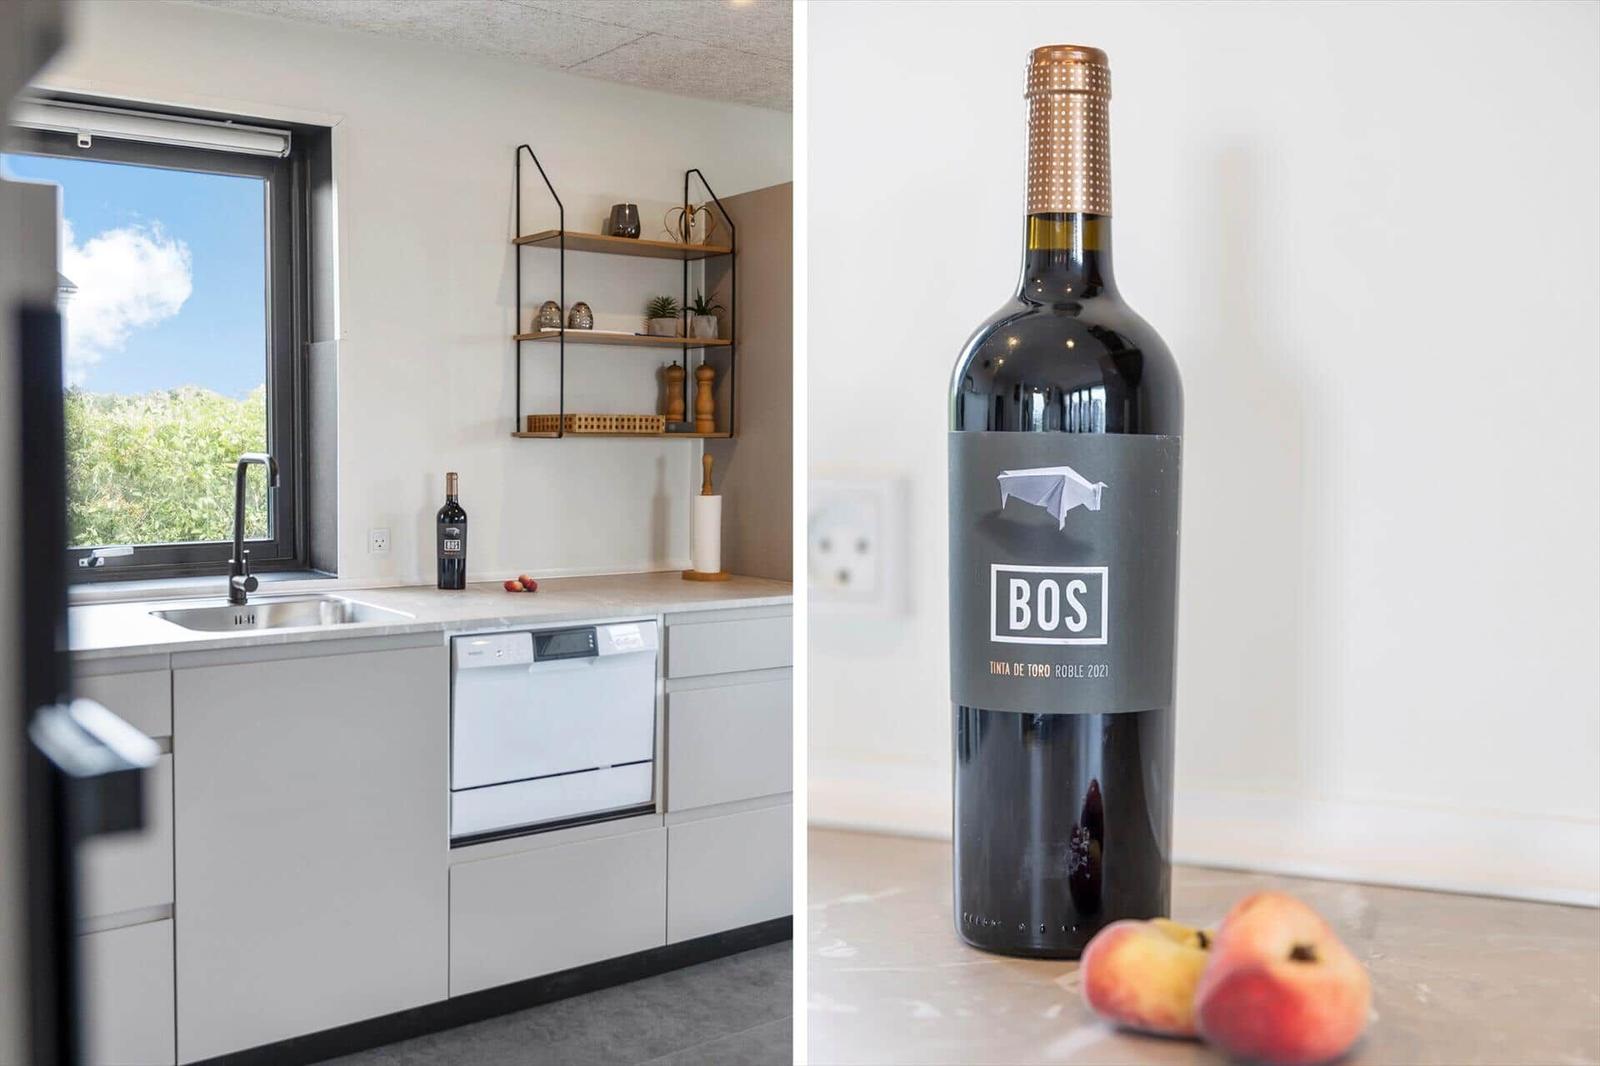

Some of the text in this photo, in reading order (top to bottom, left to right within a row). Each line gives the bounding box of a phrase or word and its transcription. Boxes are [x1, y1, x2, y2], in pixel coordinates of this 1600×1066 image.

[1009, 578, 1088, 632] BOS
[990, 661, 1109, 678] TINTA DE TORO ROBLE 2021
